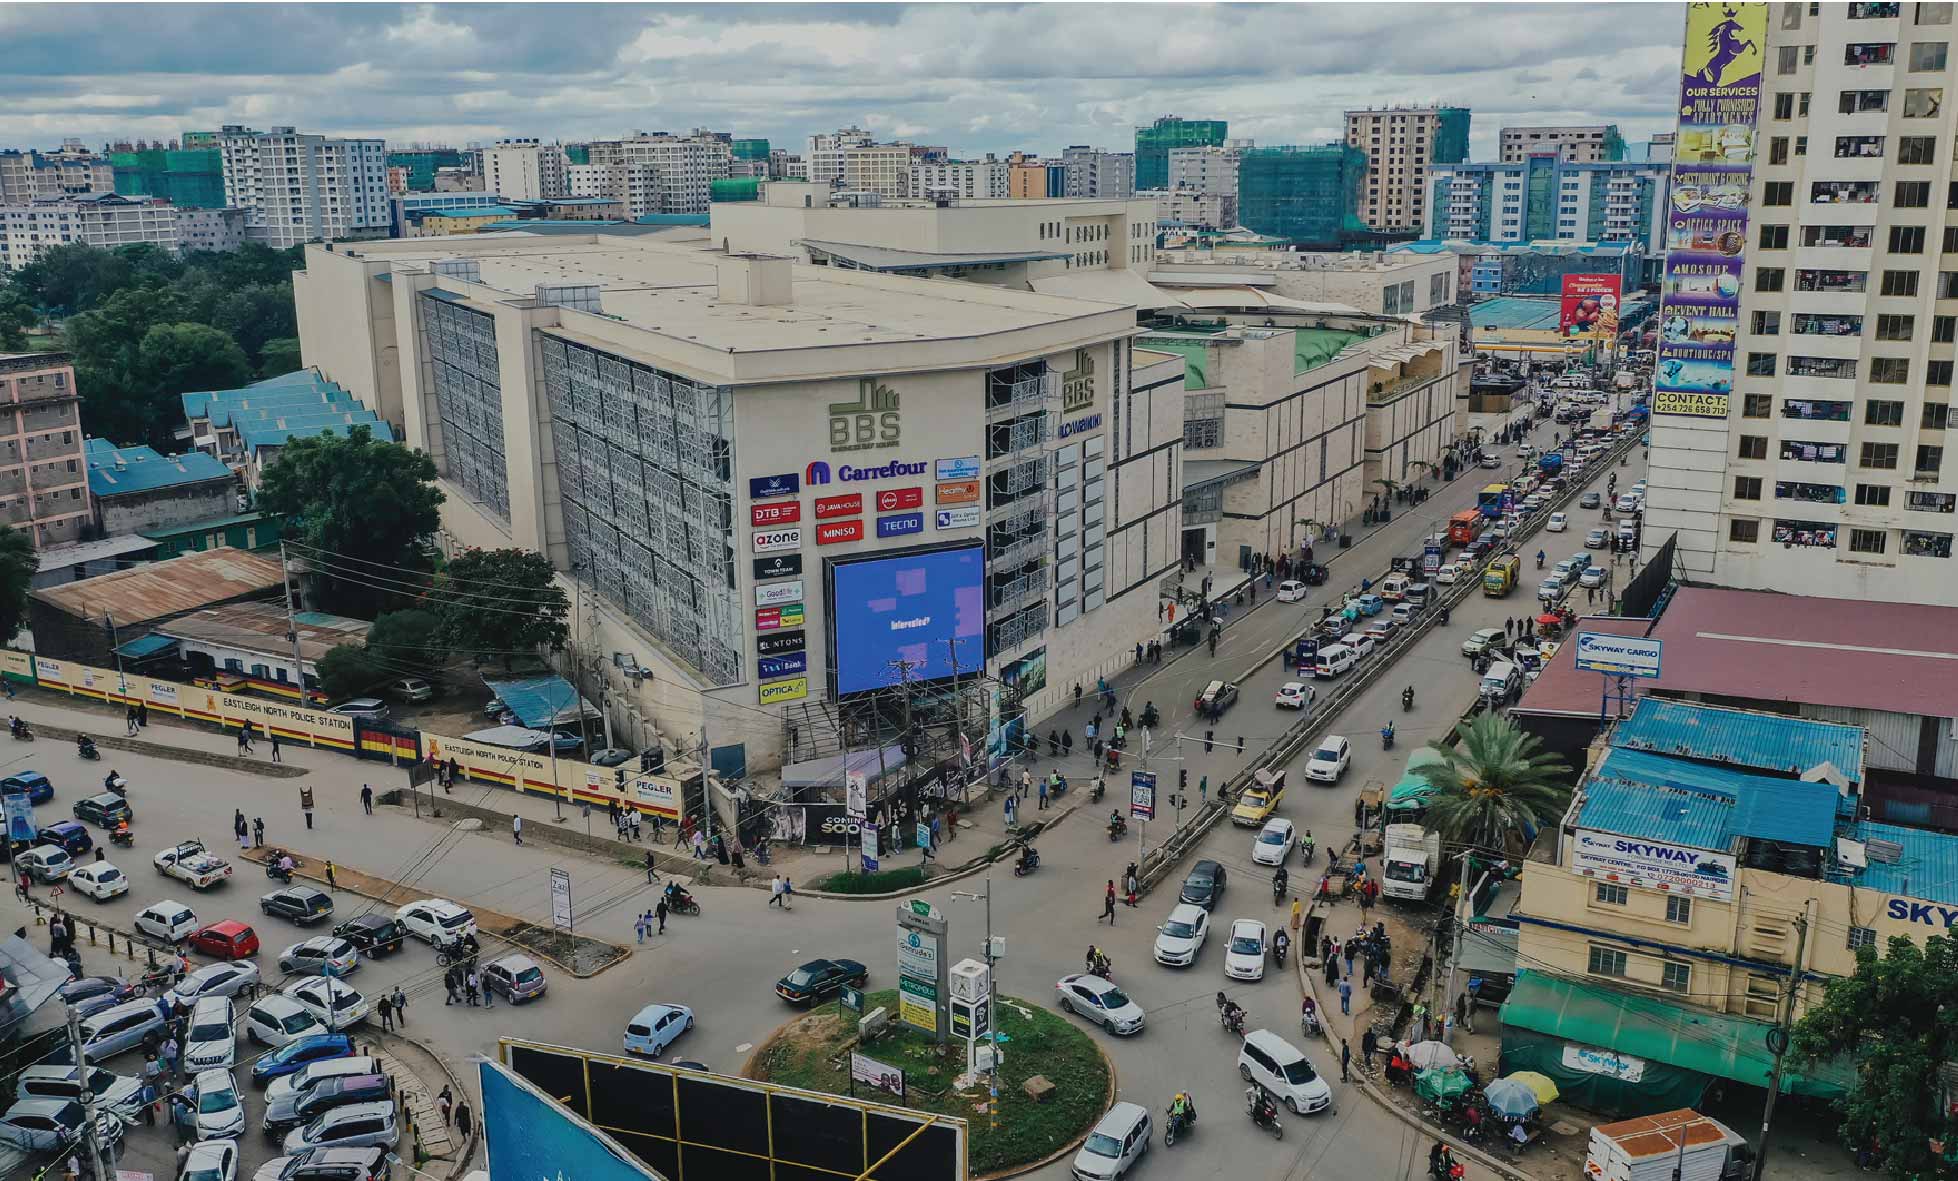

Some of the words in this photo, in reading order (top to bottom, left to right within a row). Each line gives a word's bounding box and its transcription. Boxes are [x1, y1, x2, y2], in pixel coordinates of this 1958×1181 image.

[1686, 88, 1708, 96] OUR
[1709, 87, 1758, 96] SERVICES
[1686, 217, 1713, 232] OFFICE
[1717, 218, 1742, 232] SPACE
[1681, 264, 1729, 275] MOSQUE
[1674, 304, 1707, 316] EVENT
[1709, 305, 1735, 317] HALL
[1063, 377, 1095, 409] BBS
[1657, 393, 1727, 406] CONTACT:
[1657, 404, 1678, 412] +254
[830, 412, 900, 445] BBS
[838, 460, 928, 482] Carrefour
[755, 508, 779, 519] DTB
[885, 519, 918, 531] TECNO
[756, 531, 799, 545] azone
[823, 527, 855, 538] MINISO
[1588, 643, 1625, 653] SKYWAY
[1627, 648, 1658, 658] CARGO
[762, 685, 793, 697] OPTICA
[223, 697, 261, 713] EASTLEIGH
[263, 706, 288, 719] NORTH
[290, 710, 316, 723] POLICE
[318, 716, 351, 730] STATION
[445, 744, 475, 756] EASTLEIGH
[476, 751, 496, 760] NORTH
[636, 780, 672, 794] PEGLER
[826, 816, 863, 824] COMIN
[821, 823, 861, 834] SOO
[1580, 854, 1607, 864] SKYWAY
[1615, 840, 1699, 865] SKYWAY
[1887, 898, 1958, 928] SKY
[1587, 1054, 1629, 1071] SKYWAY
